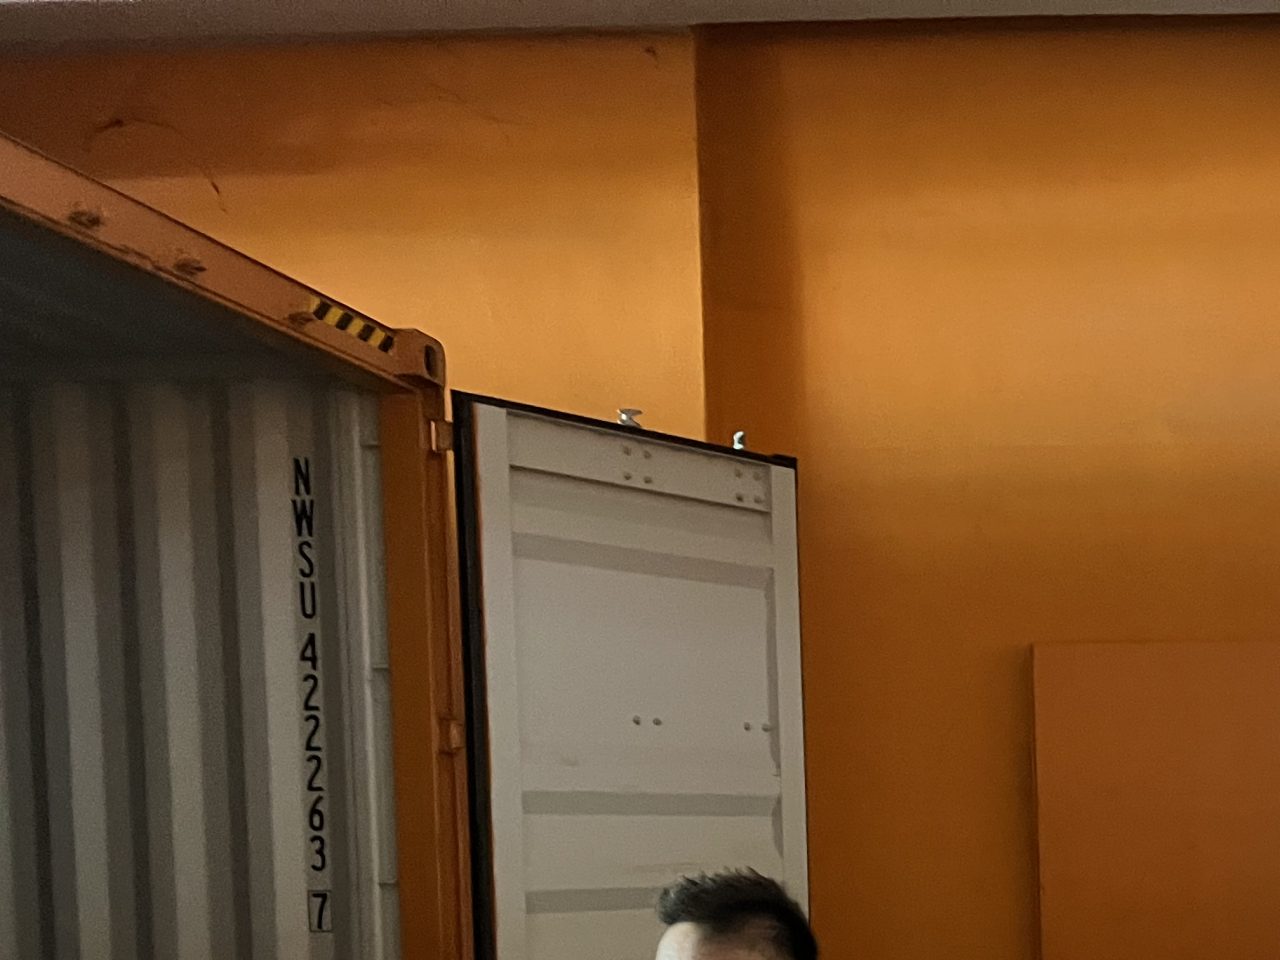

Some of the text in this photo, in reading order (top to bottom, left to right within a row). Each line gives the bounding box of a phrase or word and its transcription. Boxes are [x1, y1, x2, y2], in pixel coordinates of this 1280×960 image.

[291, 457, 329, 930] NWSU 422263 7
